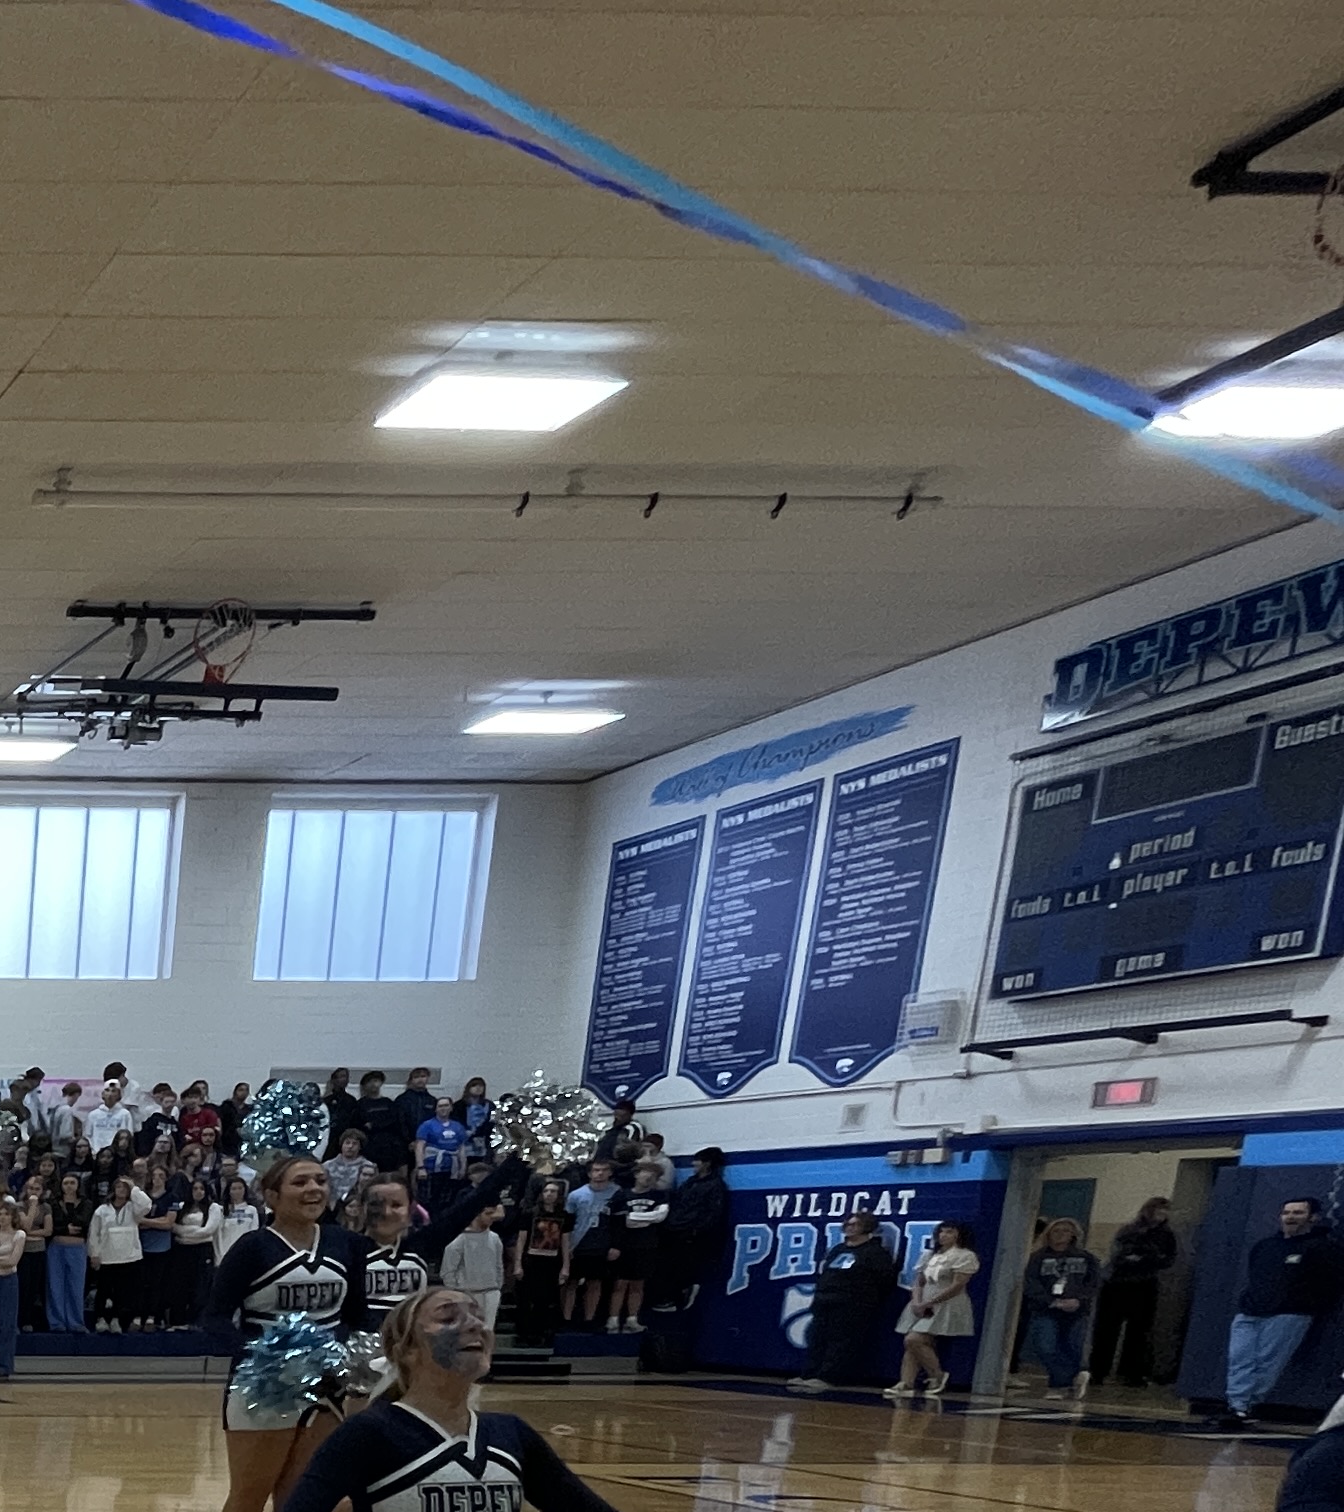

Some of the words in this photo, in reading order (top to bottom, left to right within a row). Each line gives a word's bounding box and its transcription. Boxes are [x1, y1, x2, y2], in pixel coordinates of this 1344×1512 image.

[1274, 716, 1344, 750] Guest
[737, 721, 876, 779] Champions
[839, 778, 865, 795] NYS
[869, 754, 948, 787] MEDALISTS
[721, 813, 744, 829] NYS
[748, 793, 814, 822] MEDALISTS
[1032, 783, 1083, 811] Home
[618, 846, 638, 860] NYS
[640, 828, 698, 853] MEDALISTS
[1128, 827, 1196, 863] period
[1271, 841, 1326, 868] fouls
[1122, 868, 1188, 898] player
[1010, 895, 1051, 919] fouls
[1260, 930, 1304, 952] won
[1115, 952, 1166, 977] game
[1002, 972, 1034, 991] won
[765, 1190, 916, 1218] WILDCAT
[276, 1281, 344, 1311] DEPEW
[366, 1269, 421, 1295] DEPEW
